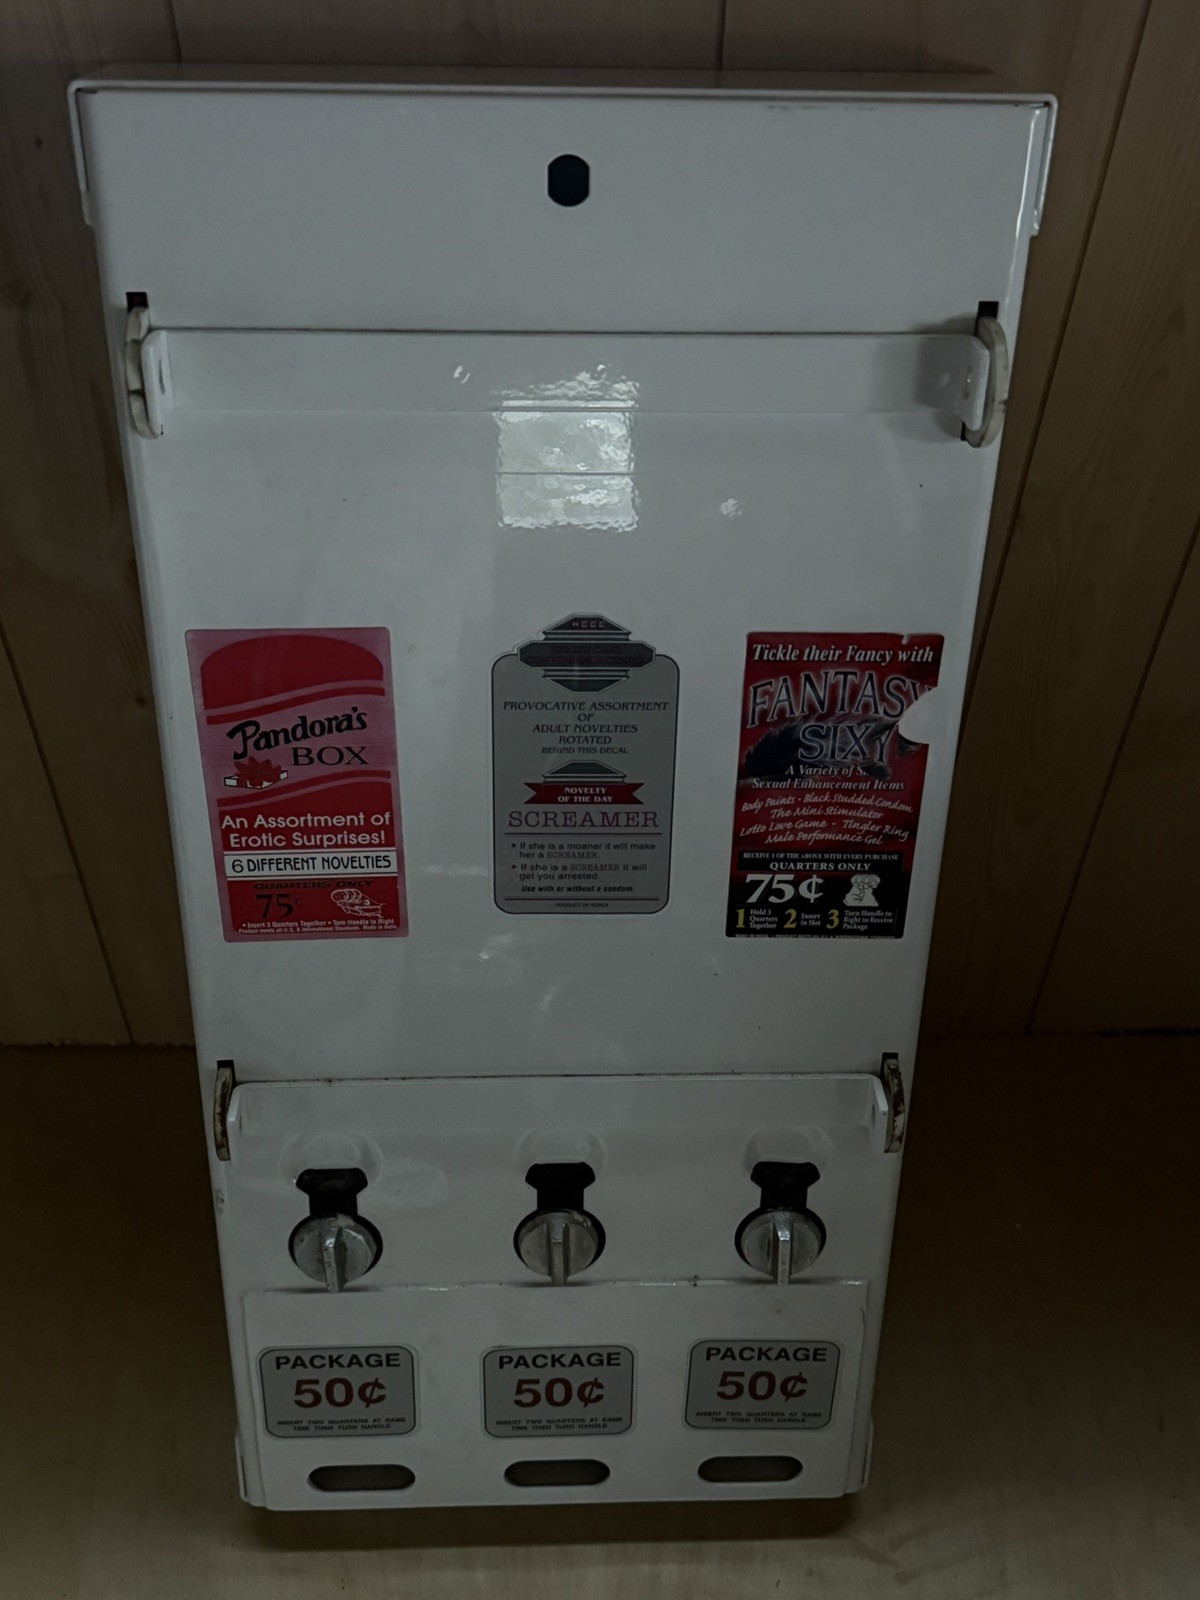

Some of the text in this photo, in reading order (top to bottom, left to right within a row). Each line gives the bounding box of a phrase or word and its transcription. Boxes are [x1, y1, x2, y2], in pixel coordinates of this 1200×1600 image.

[752, 644, 934, 666] Tickle their Fancy with
[503, 701, 669, 711] PROVOCATIVE ASSORTMENT
[577, 713, 594, 722] OF
[226, 706, 368, 760] Pandora's
[532, 724, 638, 733] ADULT NOVELTIES
[559, 735, 612, 744] ROTATED
[291, 746, 369, 766] BOX
[785, 765, 794, 775] A
[800, 765, 840, 775] Variety
[842, 766, 855, 778] of
[752, 778, 904, 790] Sexual Enhancement Items
[741, 792, 914, 813] Body Paints Black Studded Condom
[222, 812, 391, 829] An Assortment of
[508, 811, 659, 827] SCREAMER
[770, 805, 884, 819] The Mini Stimulator
[229, 830, 386, 847] Erotic Surprises!
[740, 820, 909, 842] Lotto Love Game Tingler Ring
[765, 829, 883, 846] Male Performance Gel
[232, 856, 392, 873] 6 DIFFERENT NOVELTIES
[254, 881, 330, 889] QUARTERS
[745, 874, 825, 903] 75¢
[736, 908, 745, 928] 1
[783, 908, 797, 928] 2
[826, 909, 839, 929] 3
[275, 1353, 400, 1369] PACKAGE
[499, 1352, 621, 1369] PACKAGE
[705, 1348, 827, 1362] PACKAGE
[294, 1378, 386, 1408] 50¢
[514, 1377, 604, 1408] 50¢
[717, 1371, 808, 1402] 50¢
